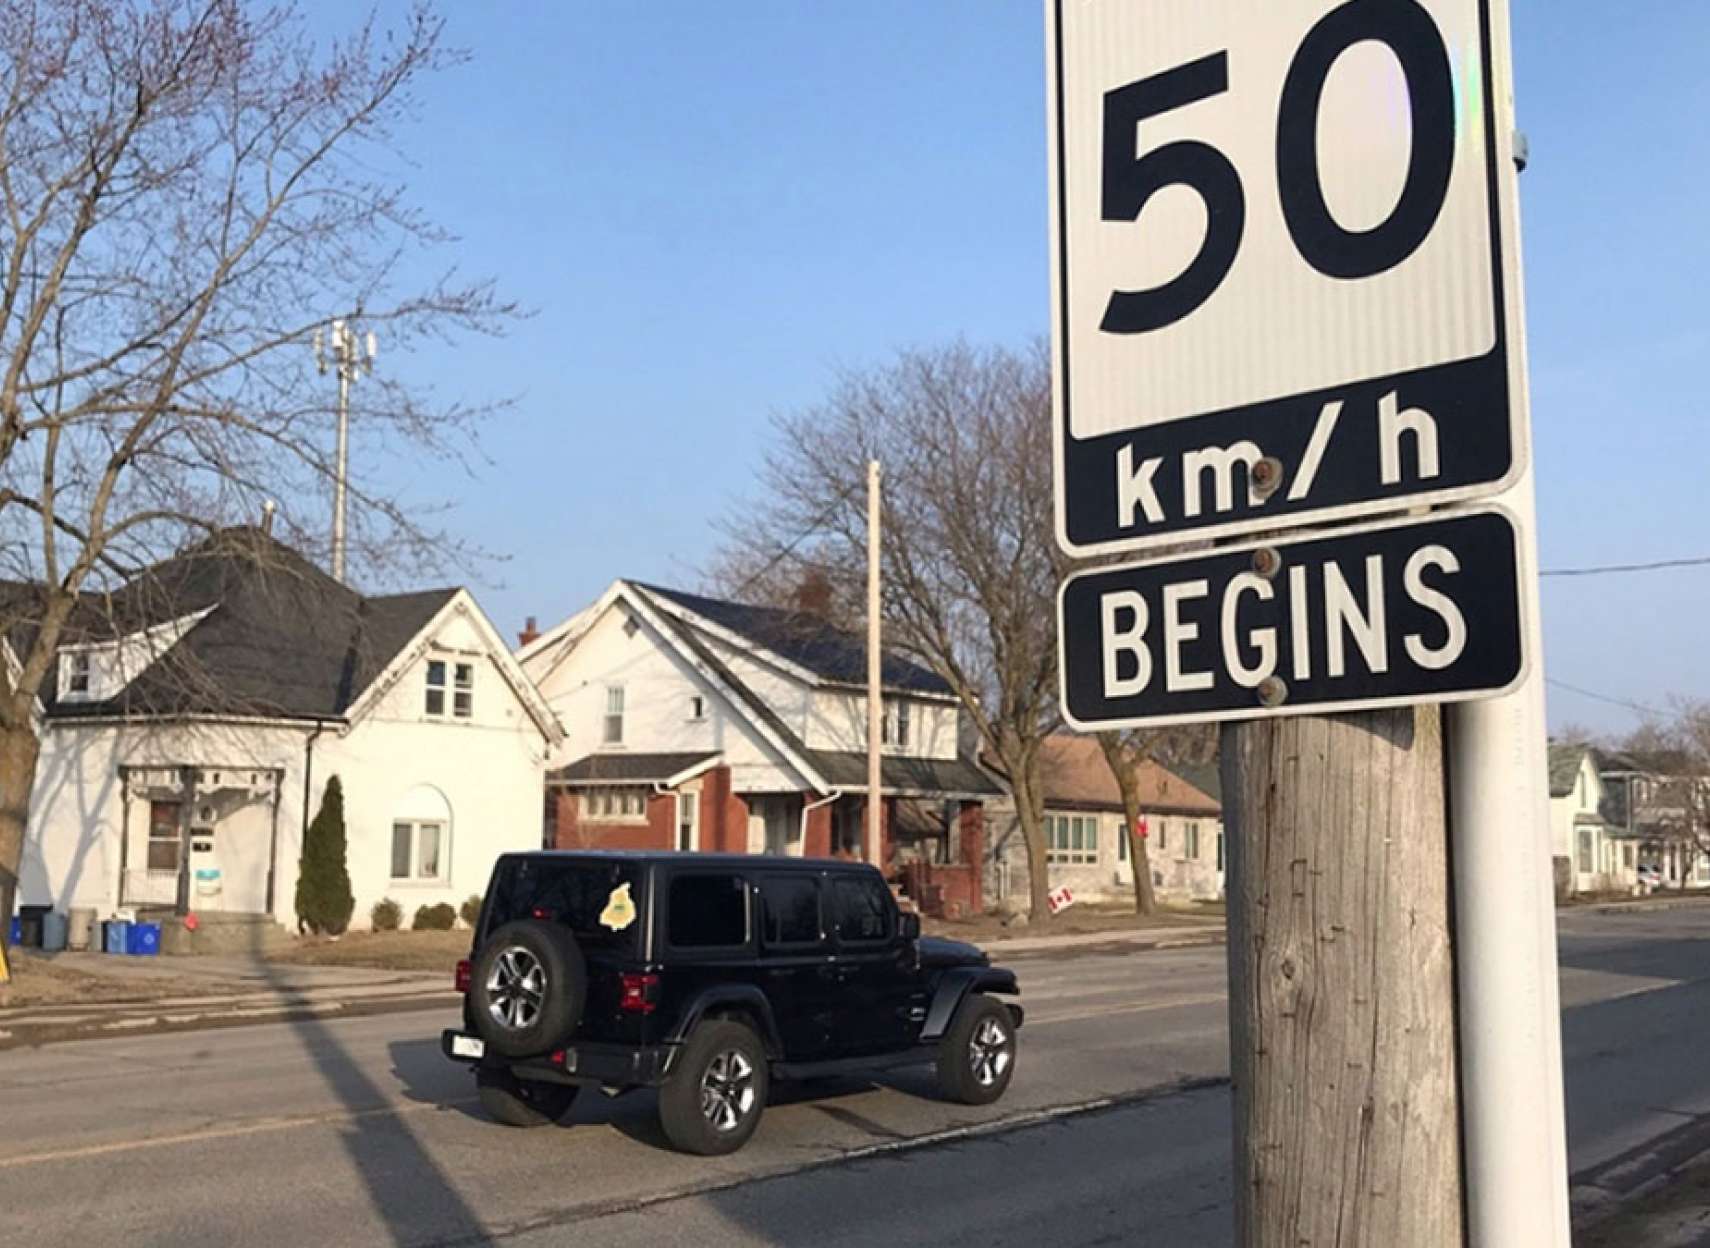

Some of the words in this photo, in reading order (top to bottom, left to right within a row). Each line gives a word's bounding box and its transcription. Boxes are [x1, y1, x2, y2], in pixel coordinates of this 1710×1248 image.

[1099, 0, 1457, 335] 50
[1115, 389, 1441, 529] km/h
[1101, 543, 1468, 699] BEGINS
